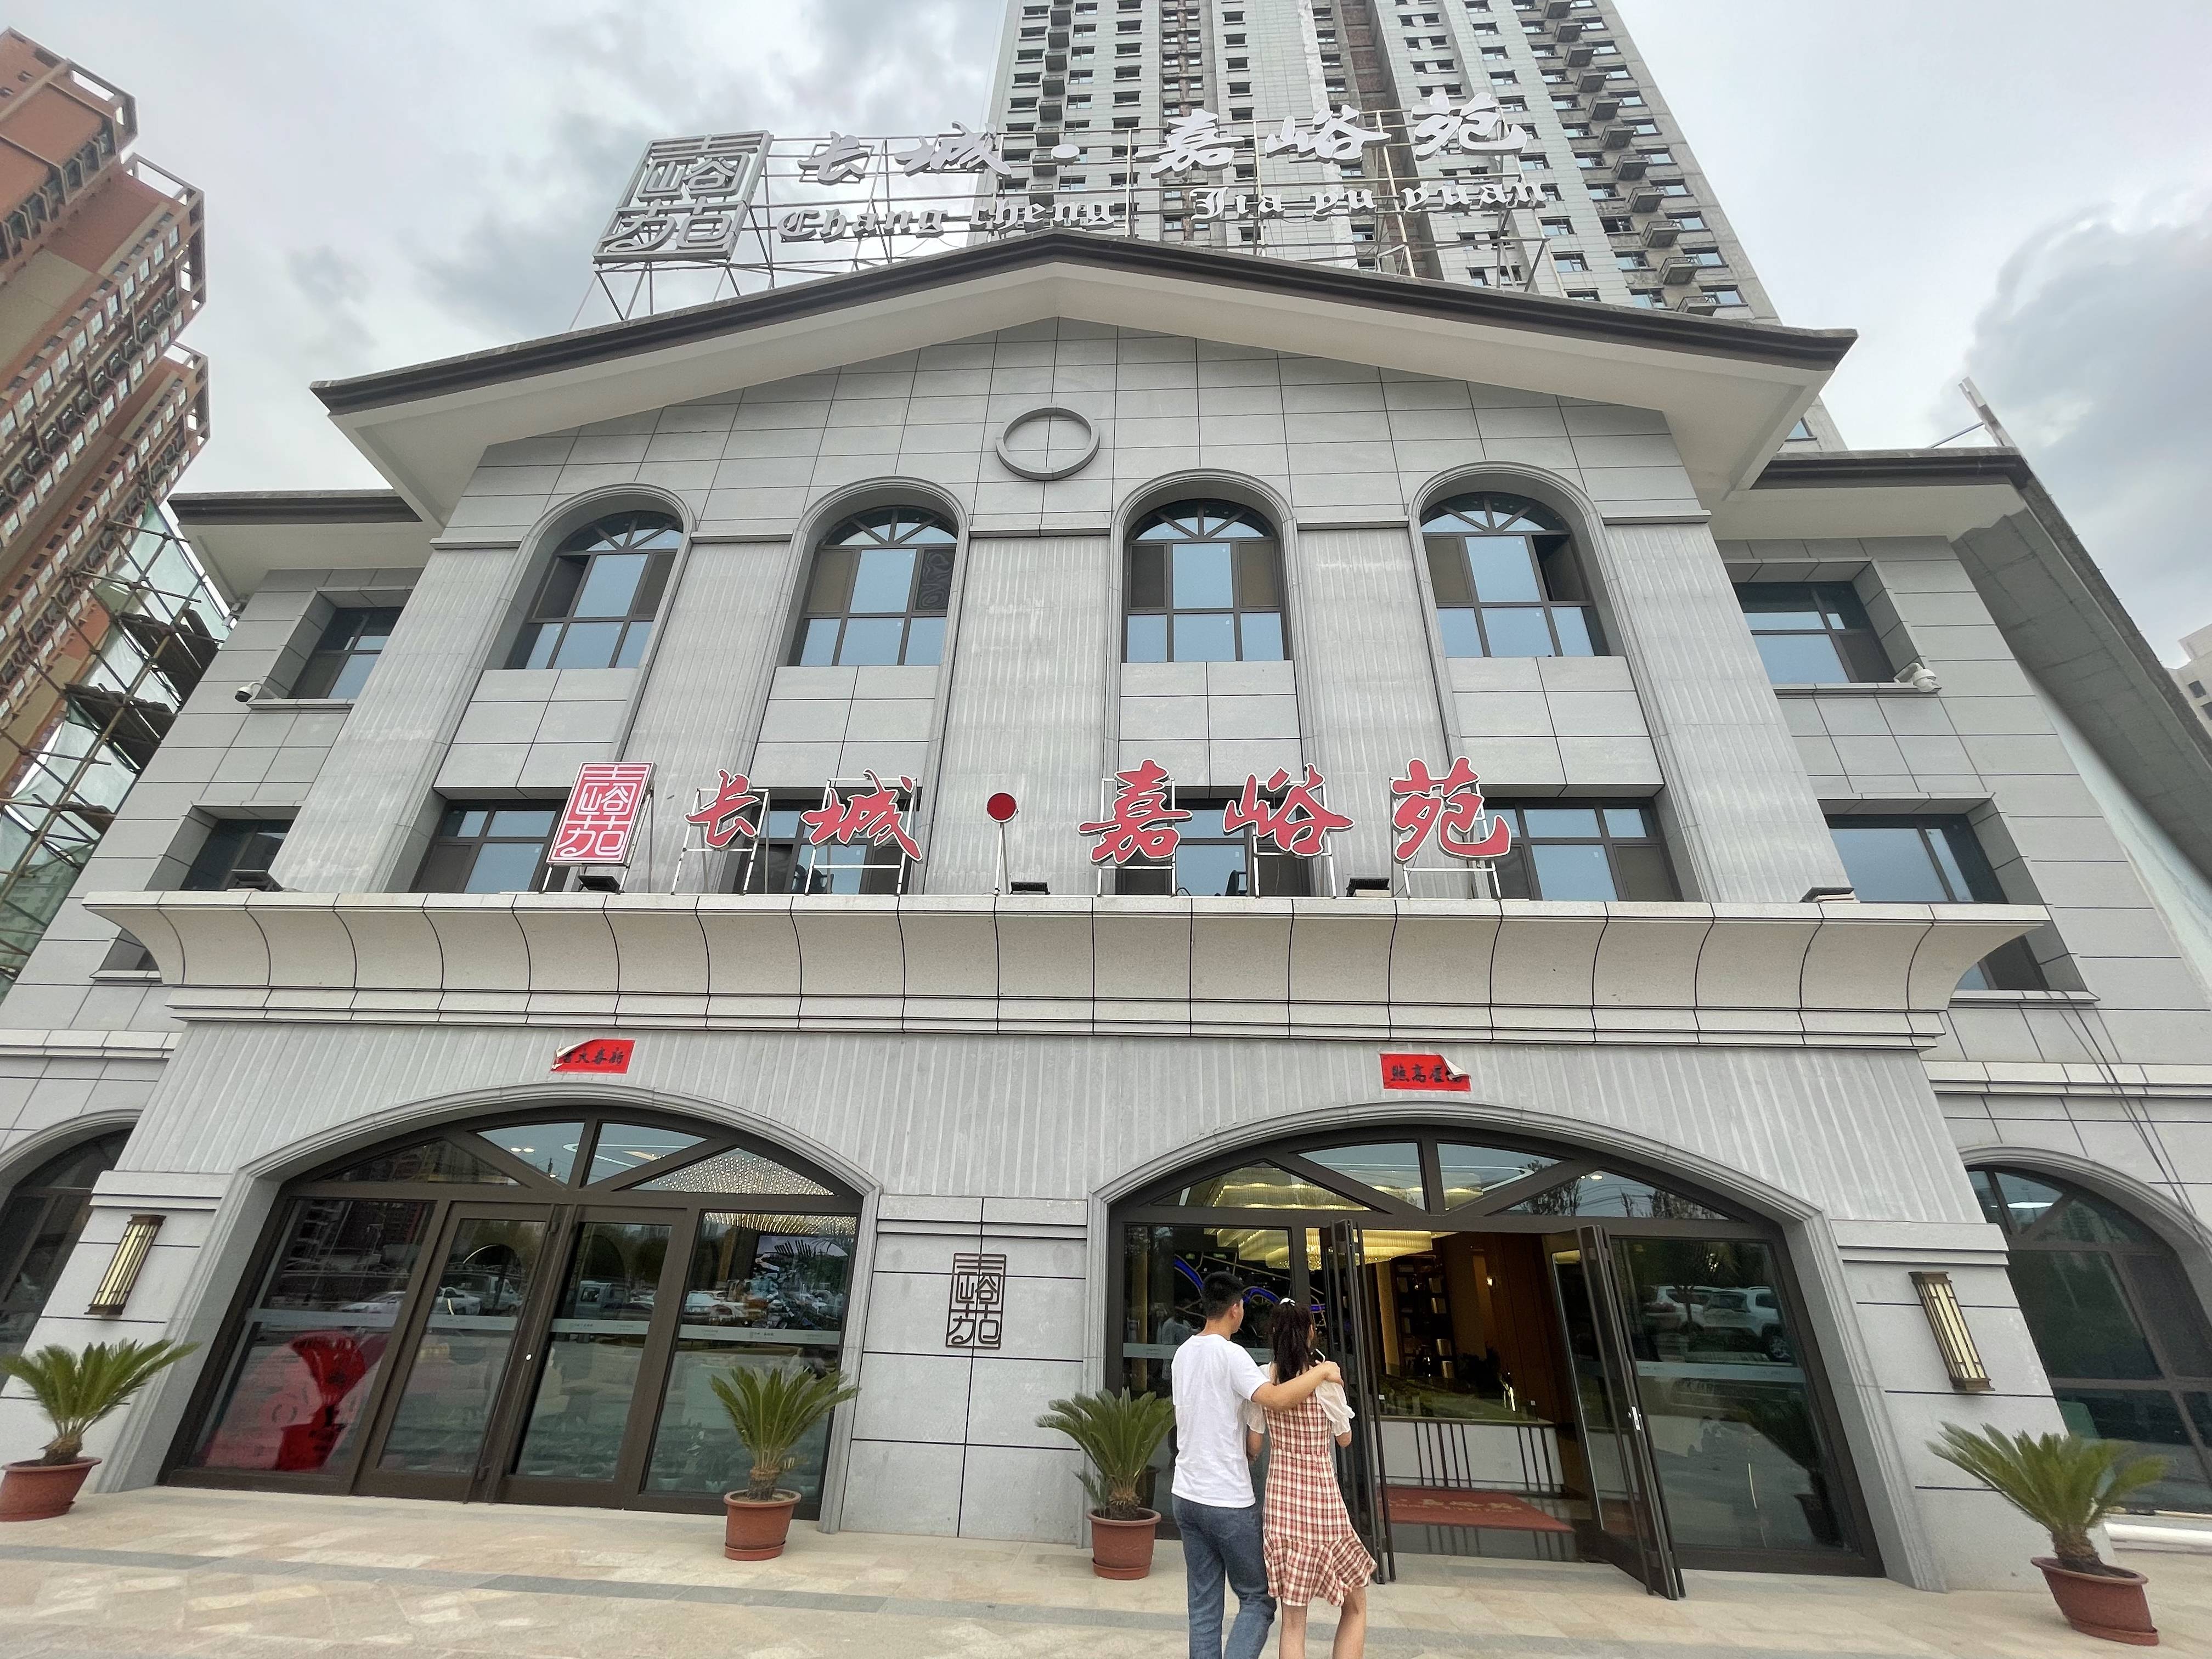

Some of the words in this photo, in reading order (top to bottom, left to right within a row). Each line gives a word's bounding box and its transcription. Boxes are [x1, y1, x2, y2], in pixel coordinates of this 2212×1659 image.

[777, 207, 949, 243] Chang
[1190, 186, 1285, 222] Jia
[1310, 183, 1378, 222] yu
[1401, 179, 1547, 214] yuan
